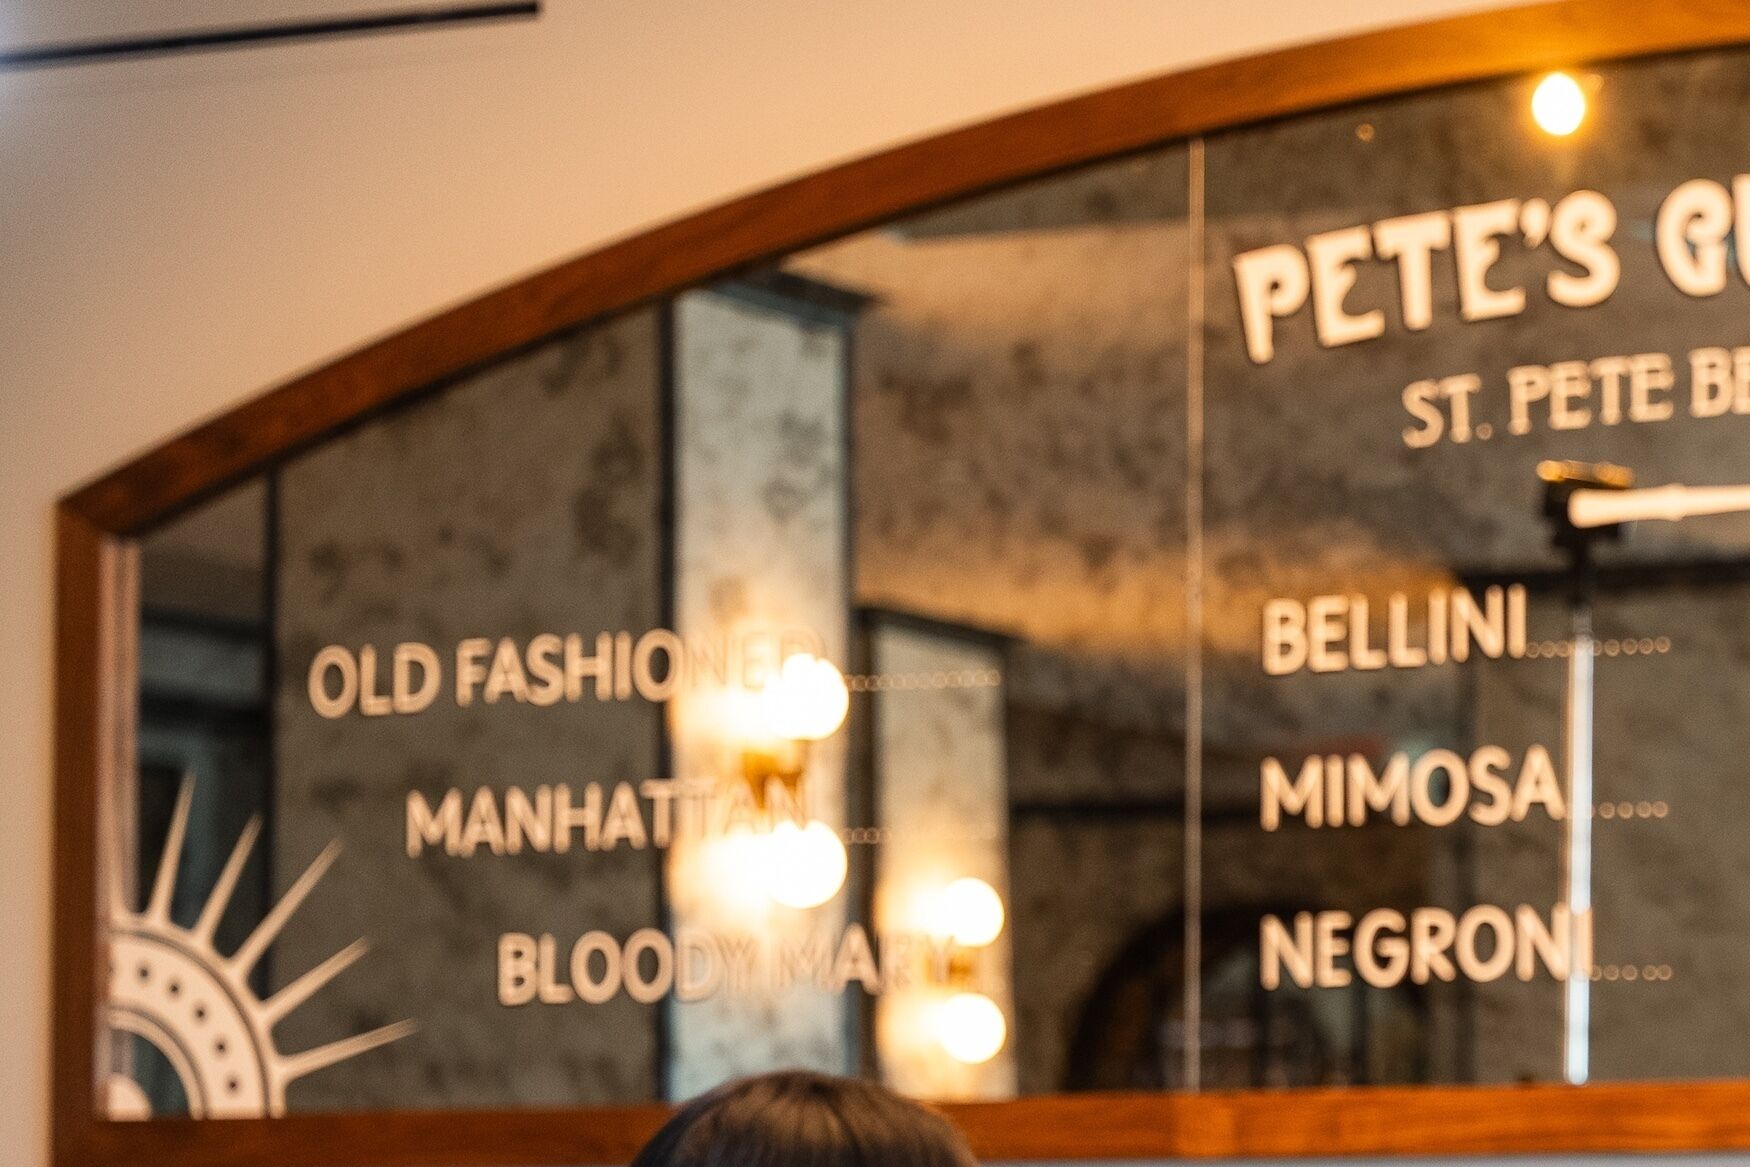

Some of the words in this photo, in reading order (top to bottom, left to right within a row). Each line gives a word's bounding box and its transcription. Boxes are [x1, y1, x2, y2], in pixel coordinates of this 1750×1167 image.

[1232, 188, 1621, 364] PETE'S
[1401, 372, 1493, 449] ST.
[1506, 351, 1676, 436] PETE
[1262, 583, 1527, 676] BELLINI
[307, 642, 441, 719] OLD
[1260, 744, 1566, 832] MIMOSA
[497, 926, 758, 1006] BLOODY
[1260, 901, 1594, 991] NEGRONI
